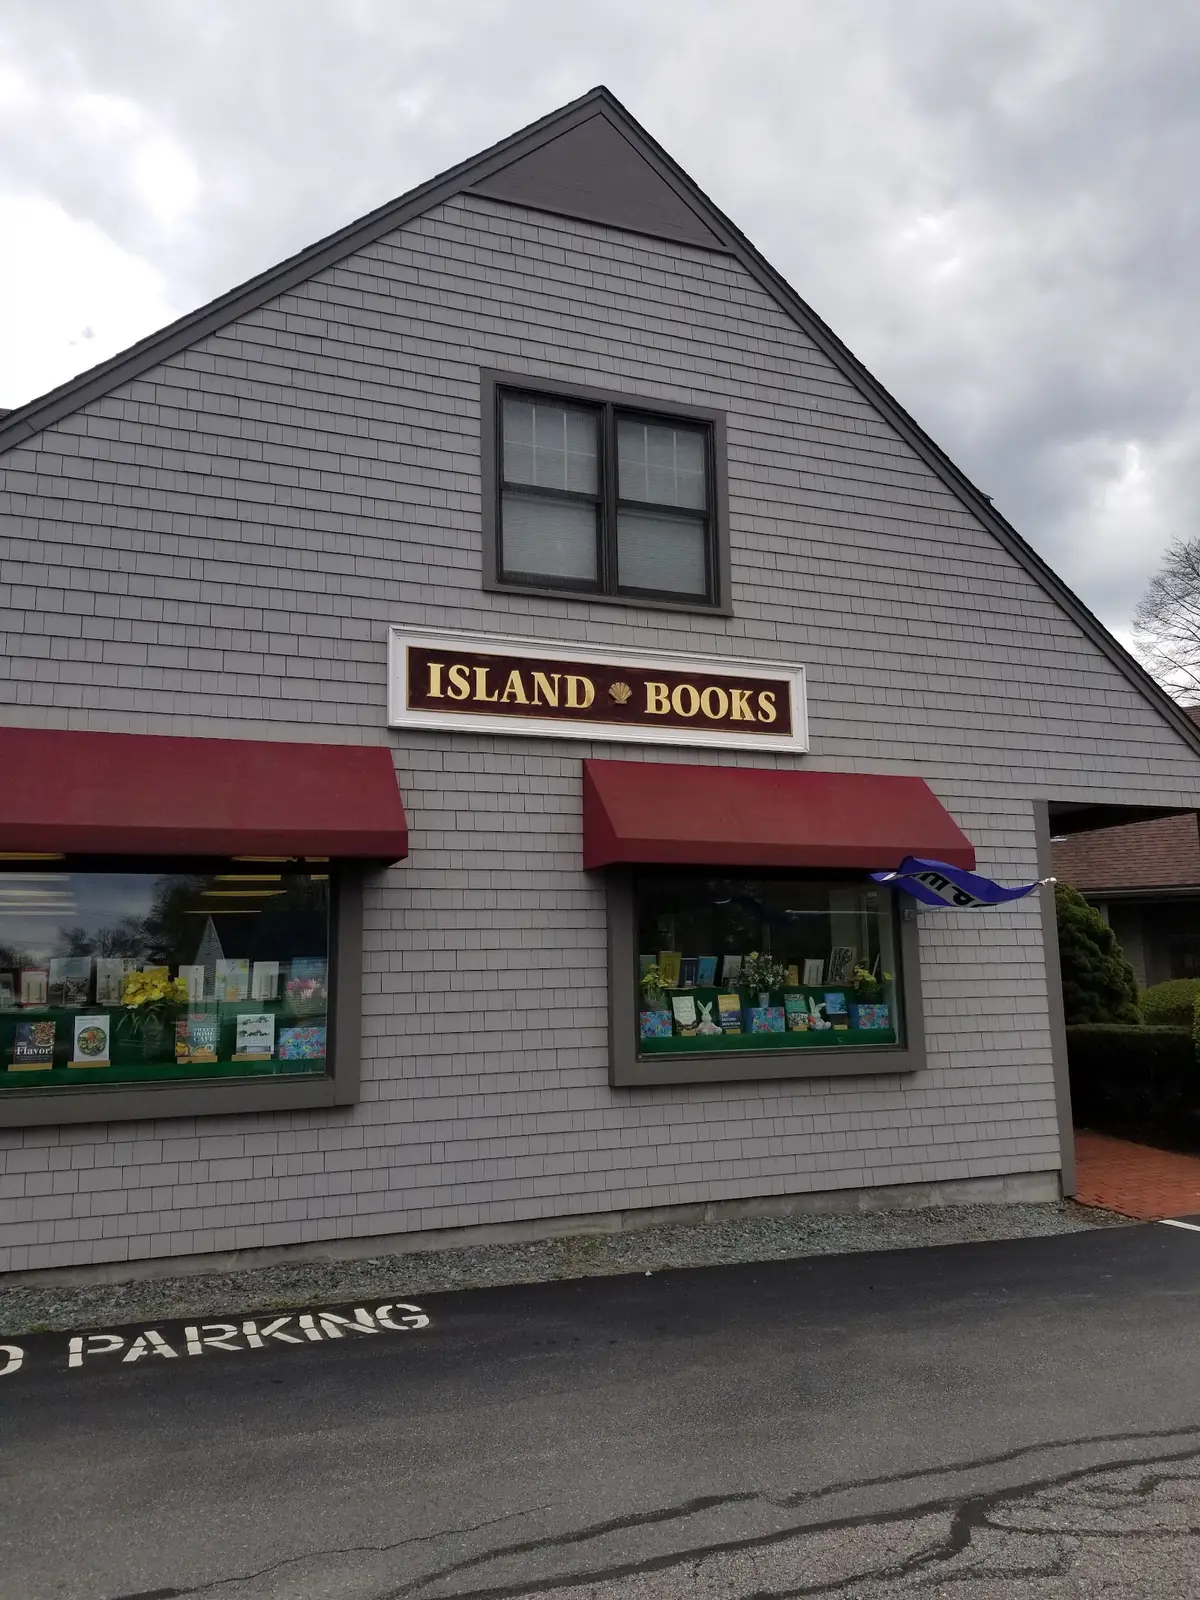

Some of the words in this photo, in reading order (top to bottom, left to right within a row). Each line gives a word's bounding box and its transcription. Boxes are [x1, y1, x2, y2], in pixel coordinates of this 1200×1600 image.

[426, 662, 596, 709] ISLAND
[643, 681, 778, 723] BOOKS
[16, 1046, 53, 1055] Flavor!
[68, 1304, 430, 1367] PARKING
